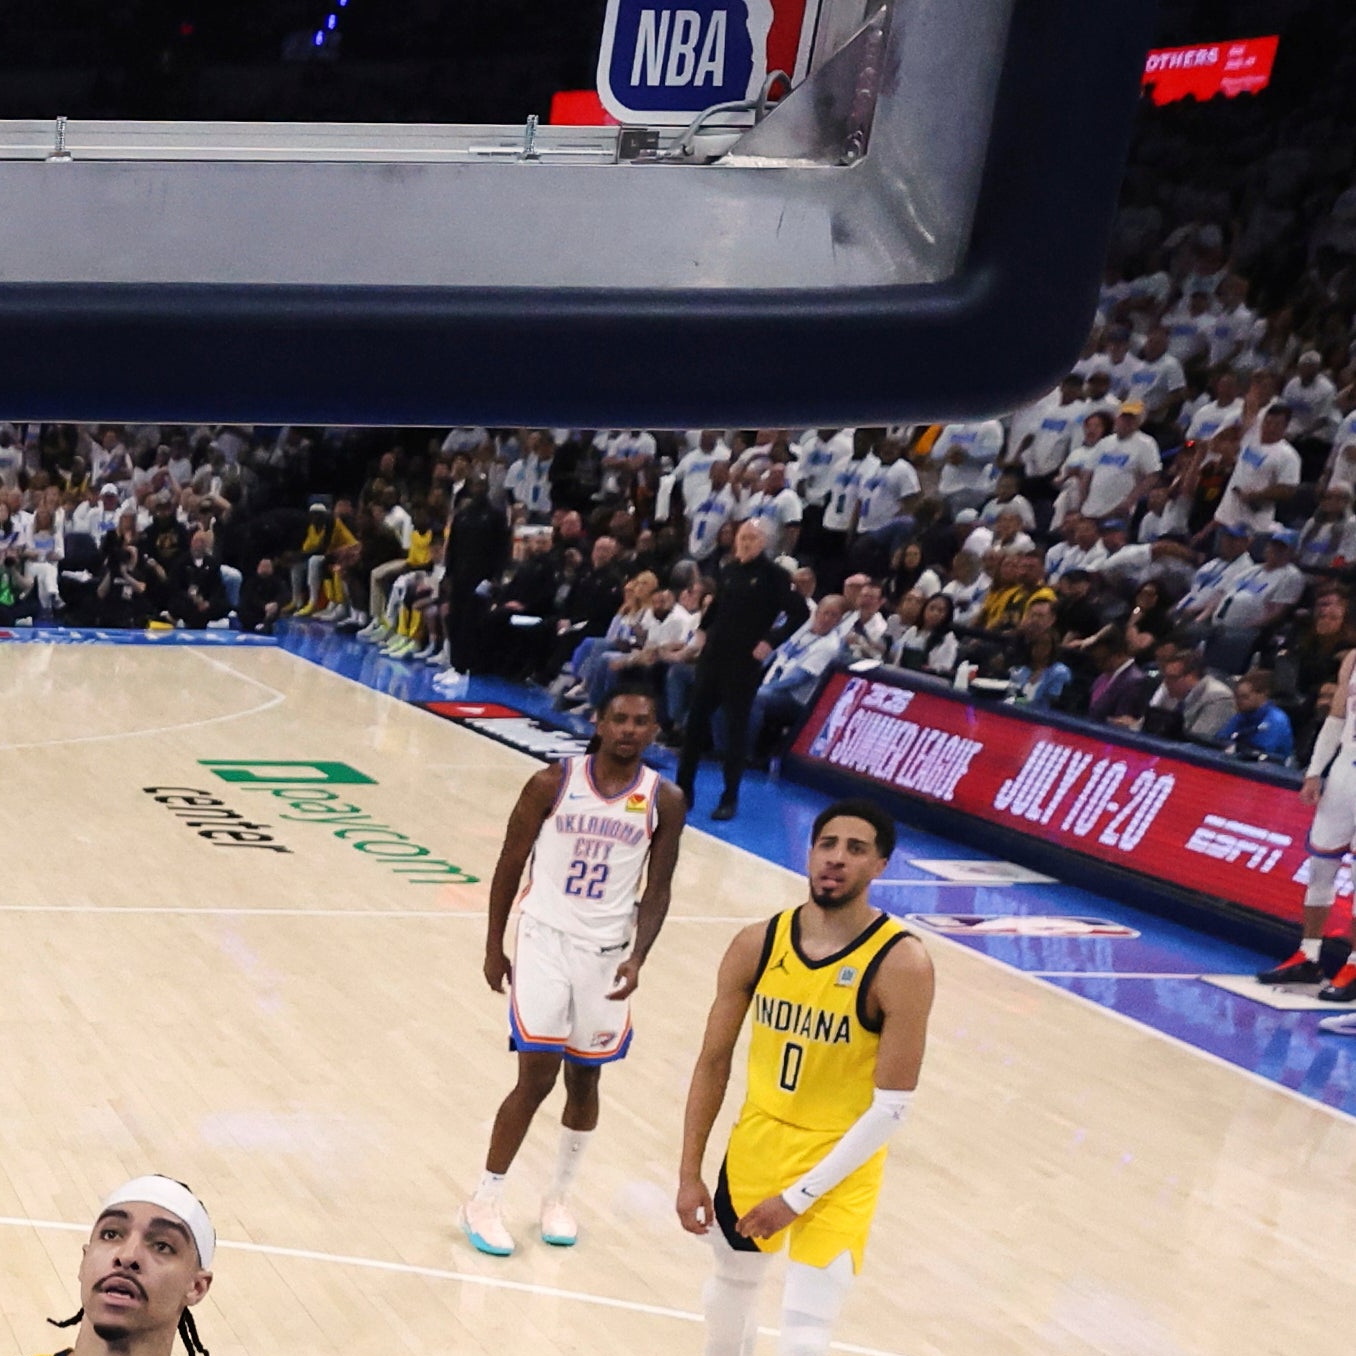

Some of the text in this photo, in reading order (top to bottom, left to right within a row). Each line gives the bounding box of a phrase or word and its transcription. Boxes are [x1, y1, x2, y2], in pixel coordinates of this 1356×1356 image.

[630, 9, 728, 87] NBA
[895, 727, 983, 801] LEAGUE
[993, 740, 1176, 851] JULY 10-20
[143, 787, 294, 853] center
[241, 787, 480, 884] paycom
[574, 837, 615, 860] CITY
[1185, 814, 1293, 874] ESPN
[565, 860, 609, 899] 22
[755, 993, 852, 1045] INDIANA
[779, 1041, 804, 1092] 0
